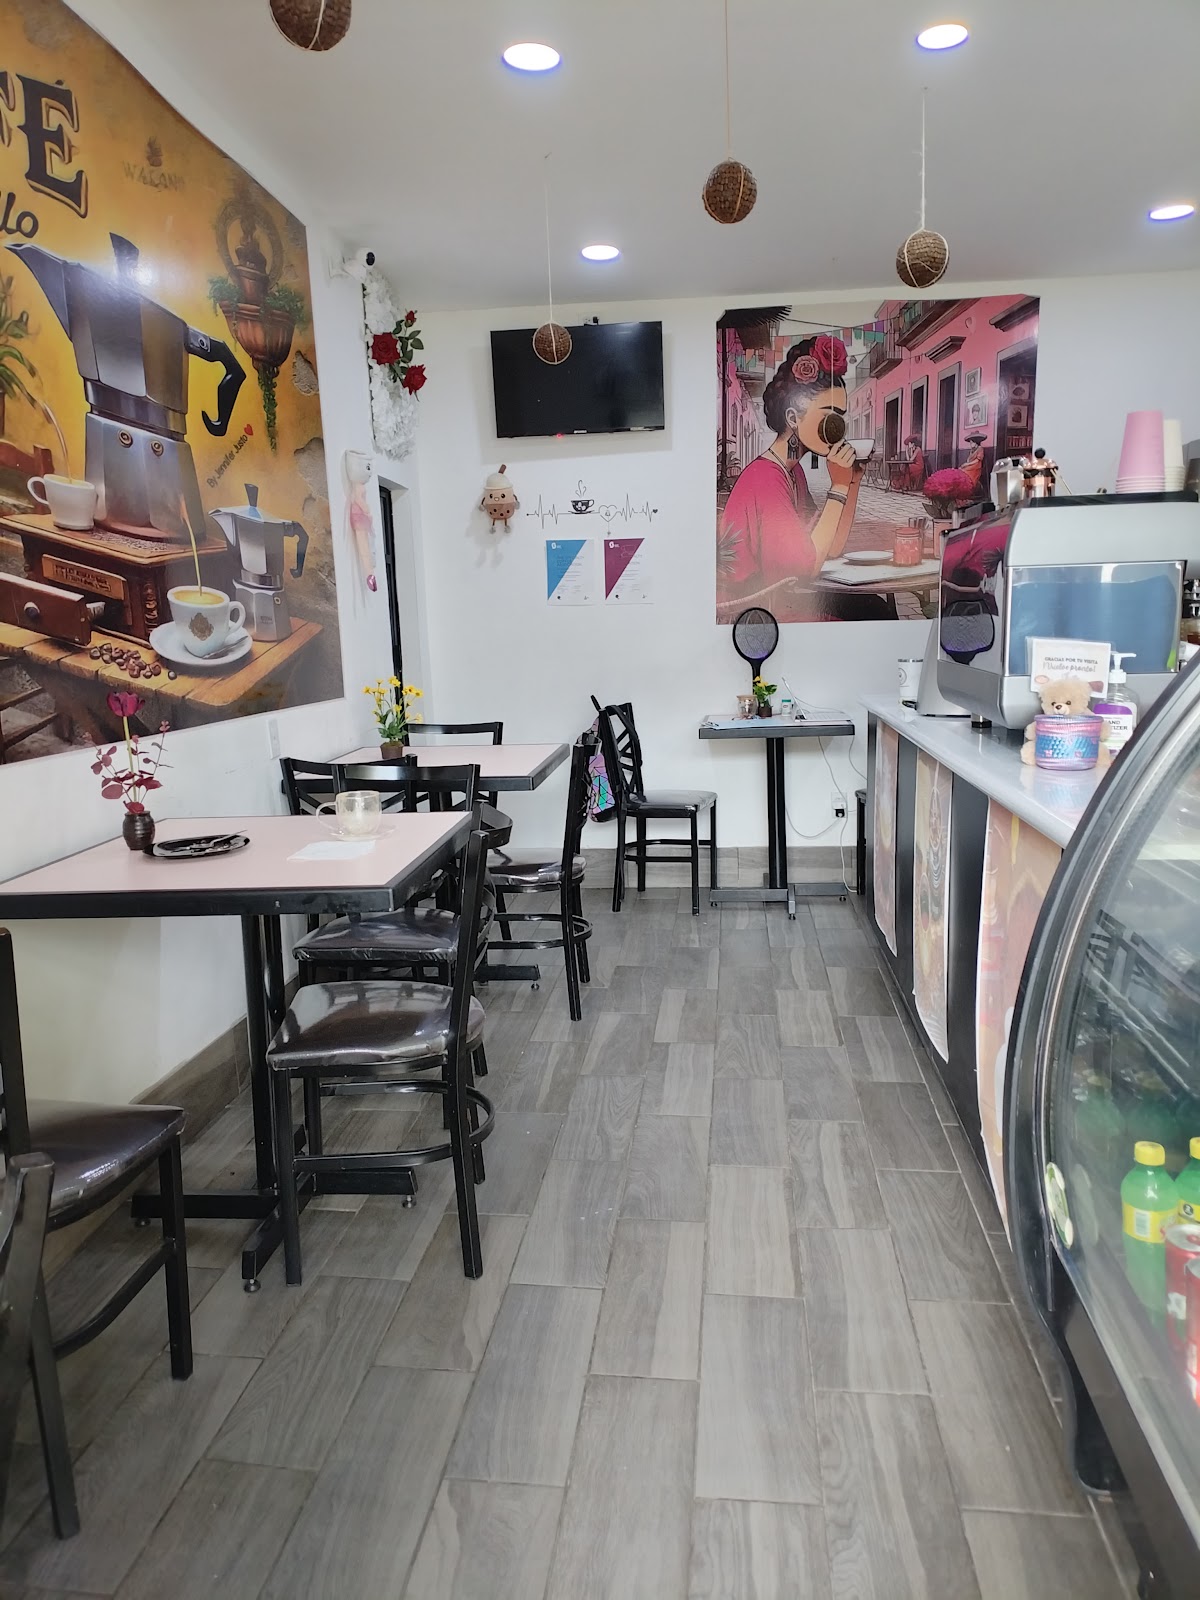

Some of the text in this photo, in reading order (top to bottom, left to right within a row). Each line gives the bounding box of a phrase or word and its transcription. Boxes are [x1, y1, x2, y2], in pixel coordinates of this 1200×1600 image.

[206, 434, 248, 488] By Jennifer Justo
